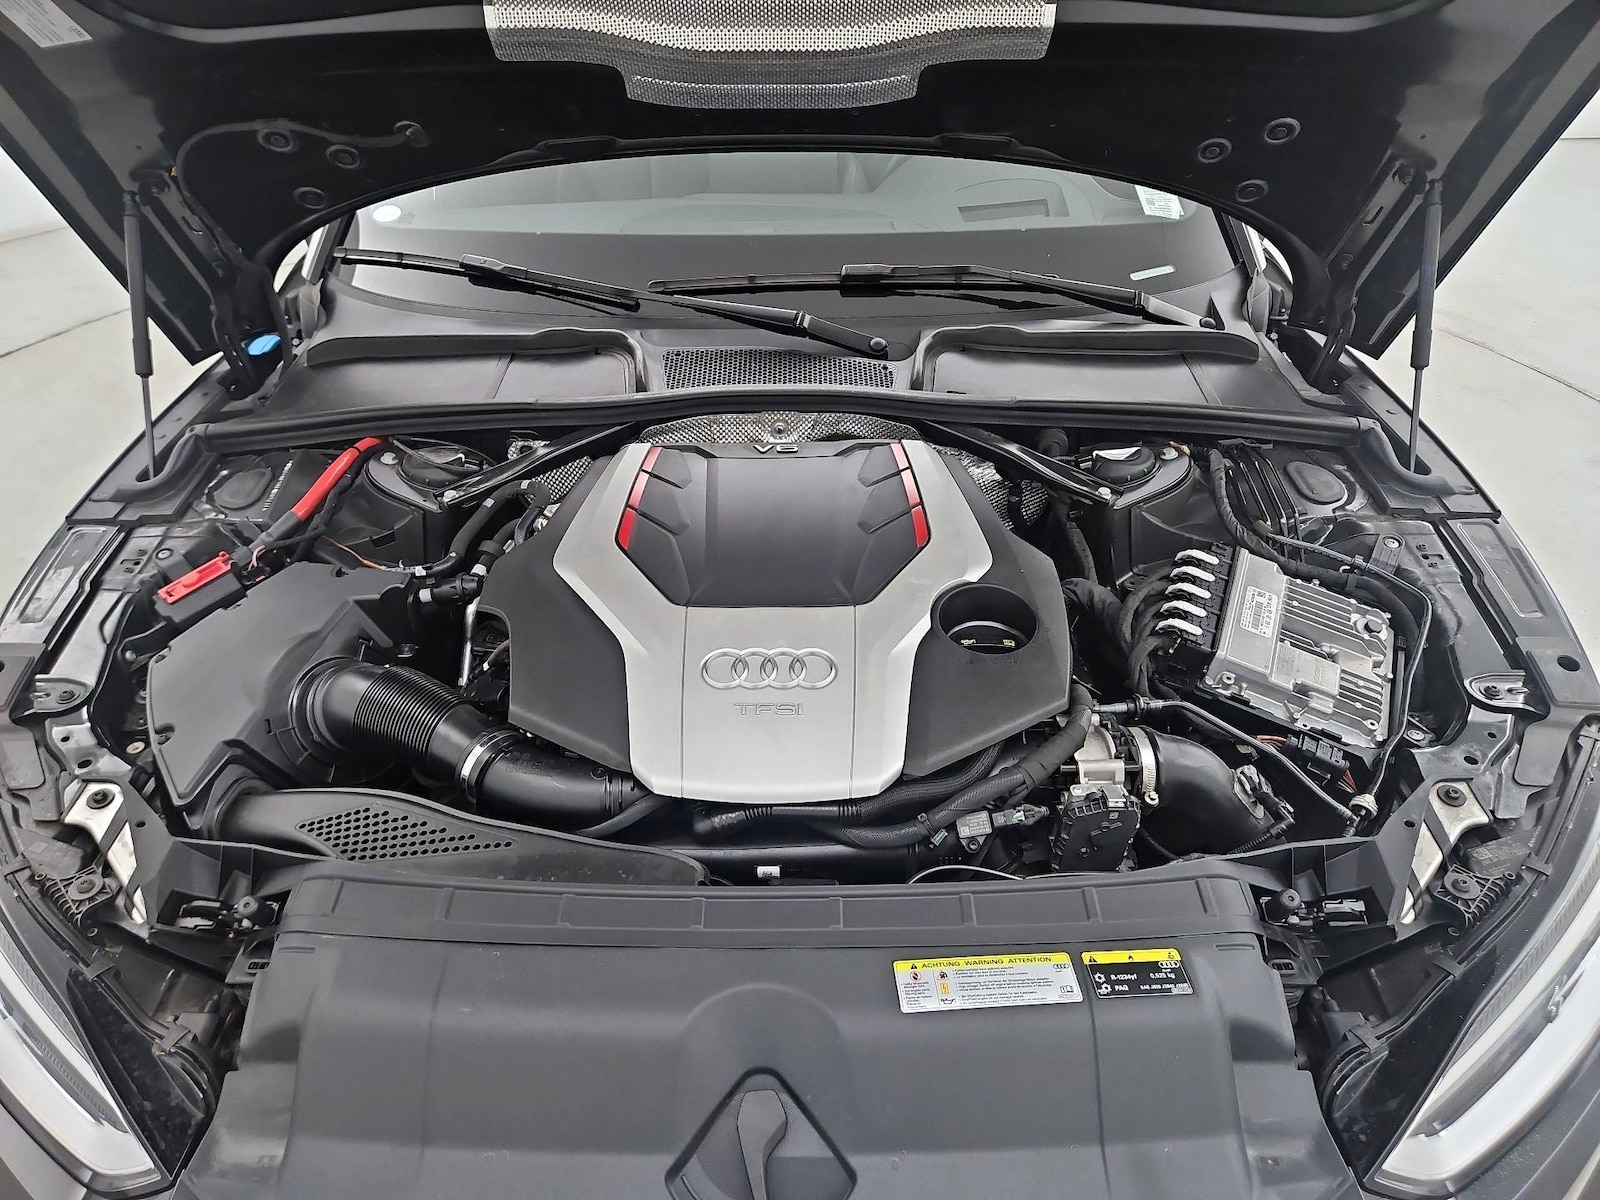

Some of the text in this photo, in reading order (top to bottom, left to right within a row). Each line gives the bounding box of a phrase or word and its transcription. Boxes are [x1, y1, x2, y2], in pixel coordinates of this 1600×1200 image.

[753, 444, 799, 454] V6
[733, 702, 804, 716] TFSI
[921, 960, 961, 969] ACHTUNG
[964, 958, 1004, 967] WARNING
[1007, 956, 1053, 965] ATTENTION
